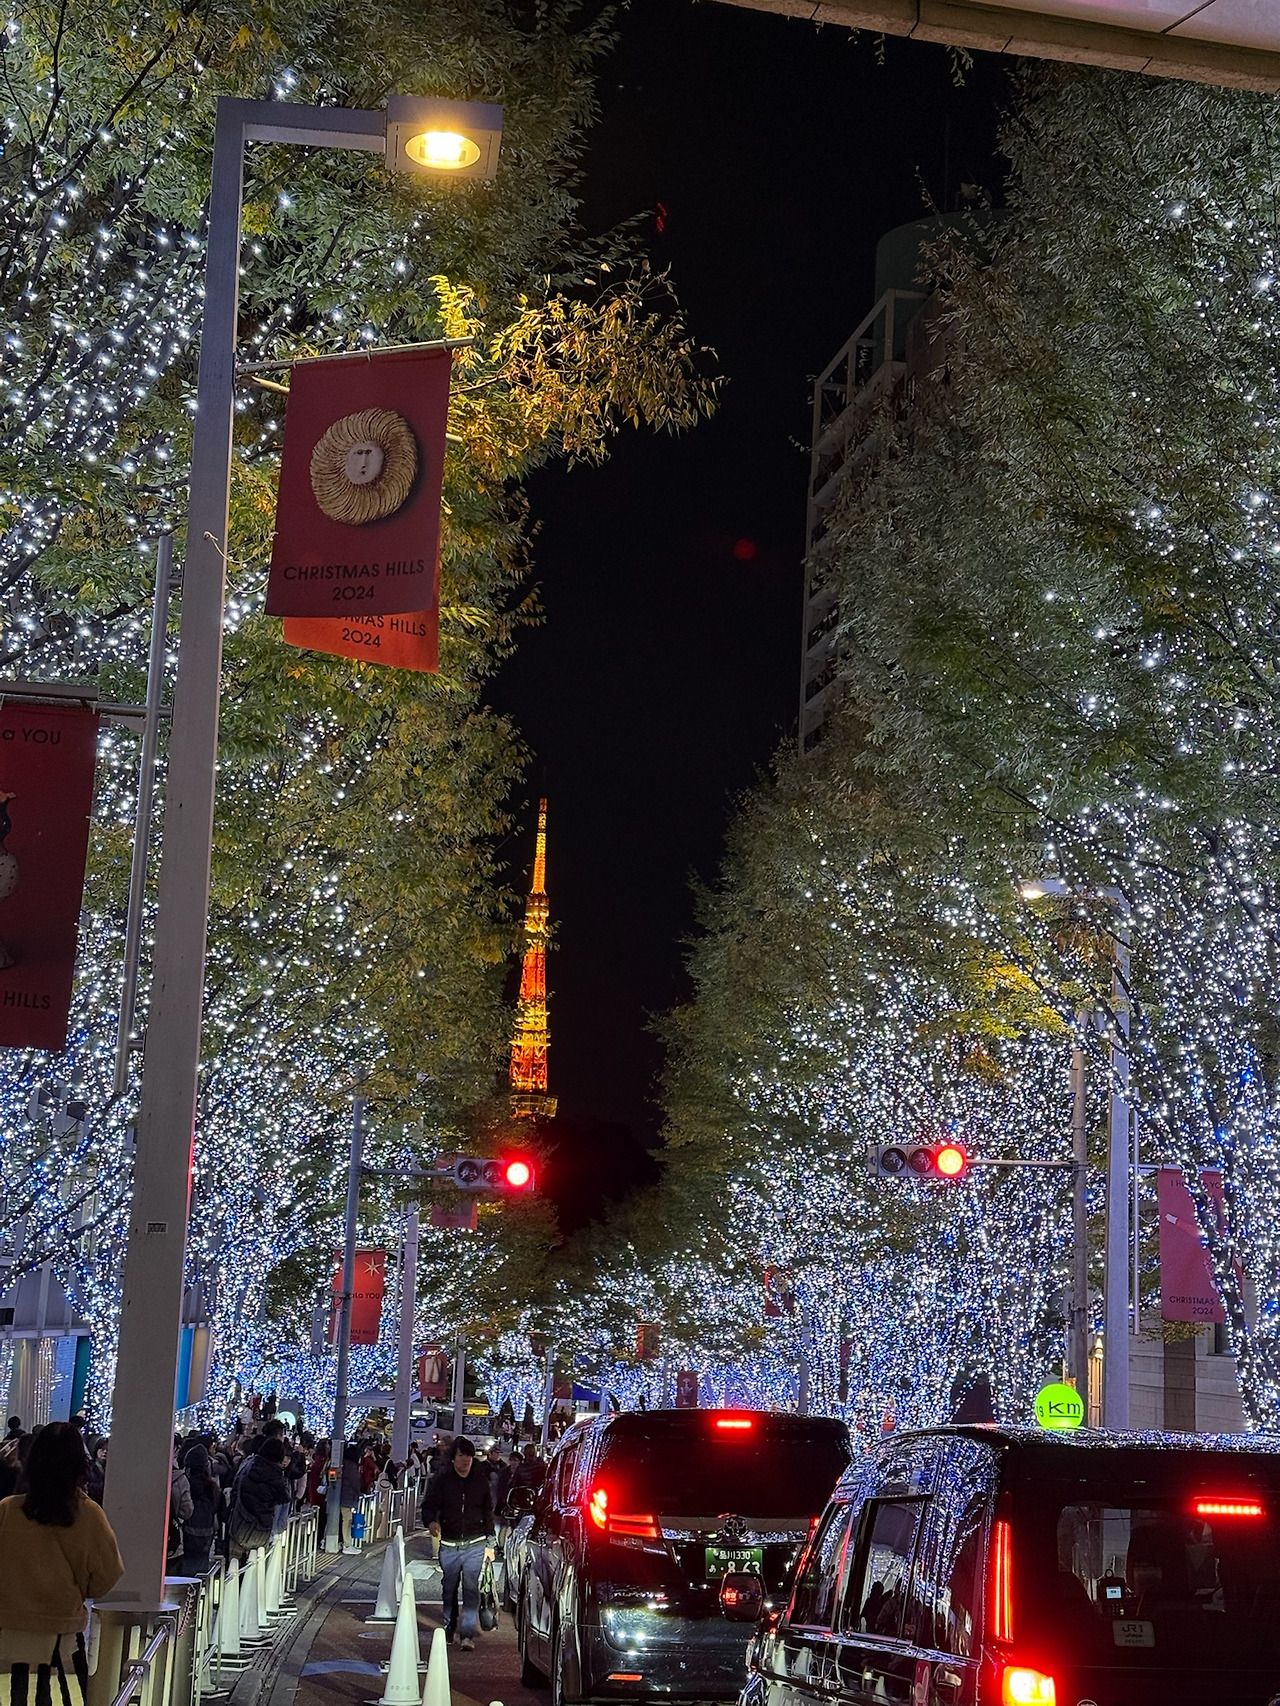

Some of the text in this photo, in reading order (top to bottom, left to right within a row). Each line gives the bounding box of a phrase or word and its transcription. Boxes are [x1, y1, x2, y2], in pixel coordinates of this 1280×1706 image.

[283, 559, 425, 581] CHRISTMAS HILLS
[332, 585, 375, 601] 2024
[390, 617, 427, 637] HILLS
[342, 627, 381, 648] 2024
[22, 727, 62, 745] YOU
[2, 990, 51, 1010] HILLS
[1169, 1295, 1215, 1306] CHRISTMAS
[1192, 1306, 1214, 1315] 2024
